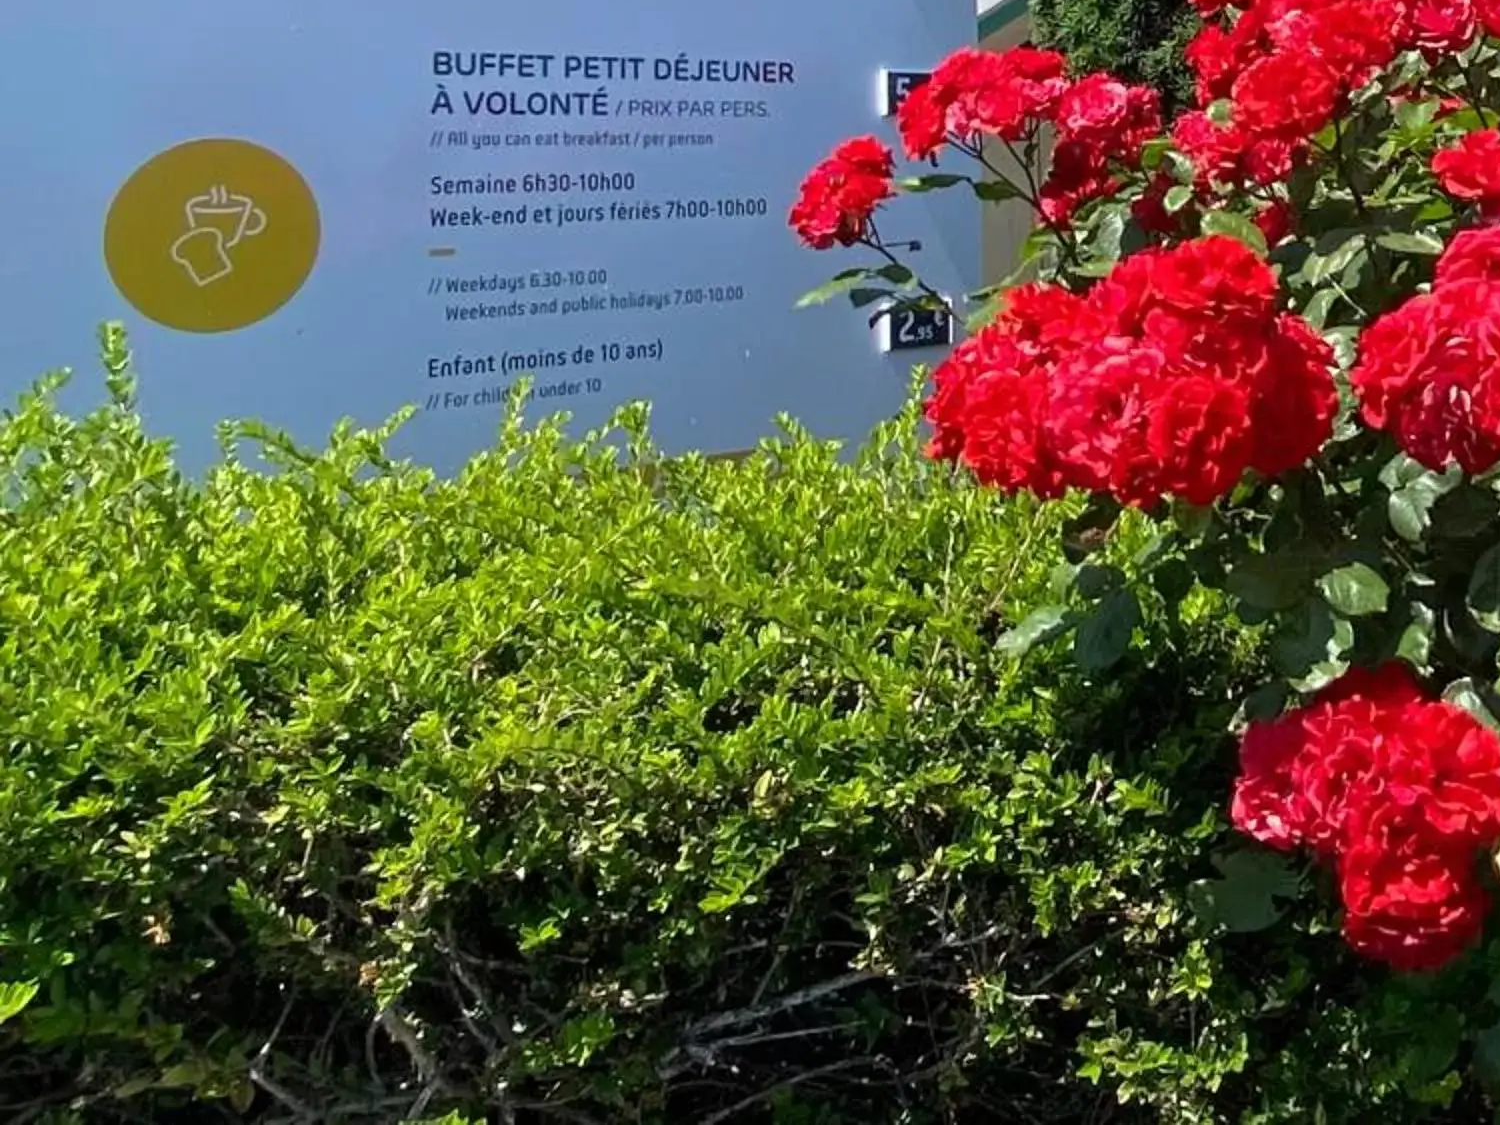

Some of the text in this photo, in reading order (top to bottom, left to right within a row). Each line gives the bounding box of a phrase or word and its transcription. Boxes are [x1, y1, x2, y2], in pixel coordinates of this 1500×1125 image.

[433, 52, 794, 83] BUFFET PETIT DÉJEUNER
[431, 84, 770, 117] À VOLONTÉ PRIX PAR PERS.
[472, 130, 713, 150] you can eat breakfast person
[431, 172, 635, 194] Semaine 6h30-10h00
[430, 205, 527, 226] Week-end
[533, 207, 552, 222] et
[557, 203, 604, 227] jours
[666, 198, 767, 218] 7h00-10h00
[446, 275, 525, 293] Weekdays
[446, 302, 525, 321] Weekends
[529, 299, 558, 315] and
[562, 295, 607, 315] public
[610, 291, 671, 310] holidays
[428, 339, 663, 378] Enfant (moins de 10 ans)
[444, 393, 469, 409] For
[539, 381, 580, 399] under
[586, 378, 601, 393] 10
